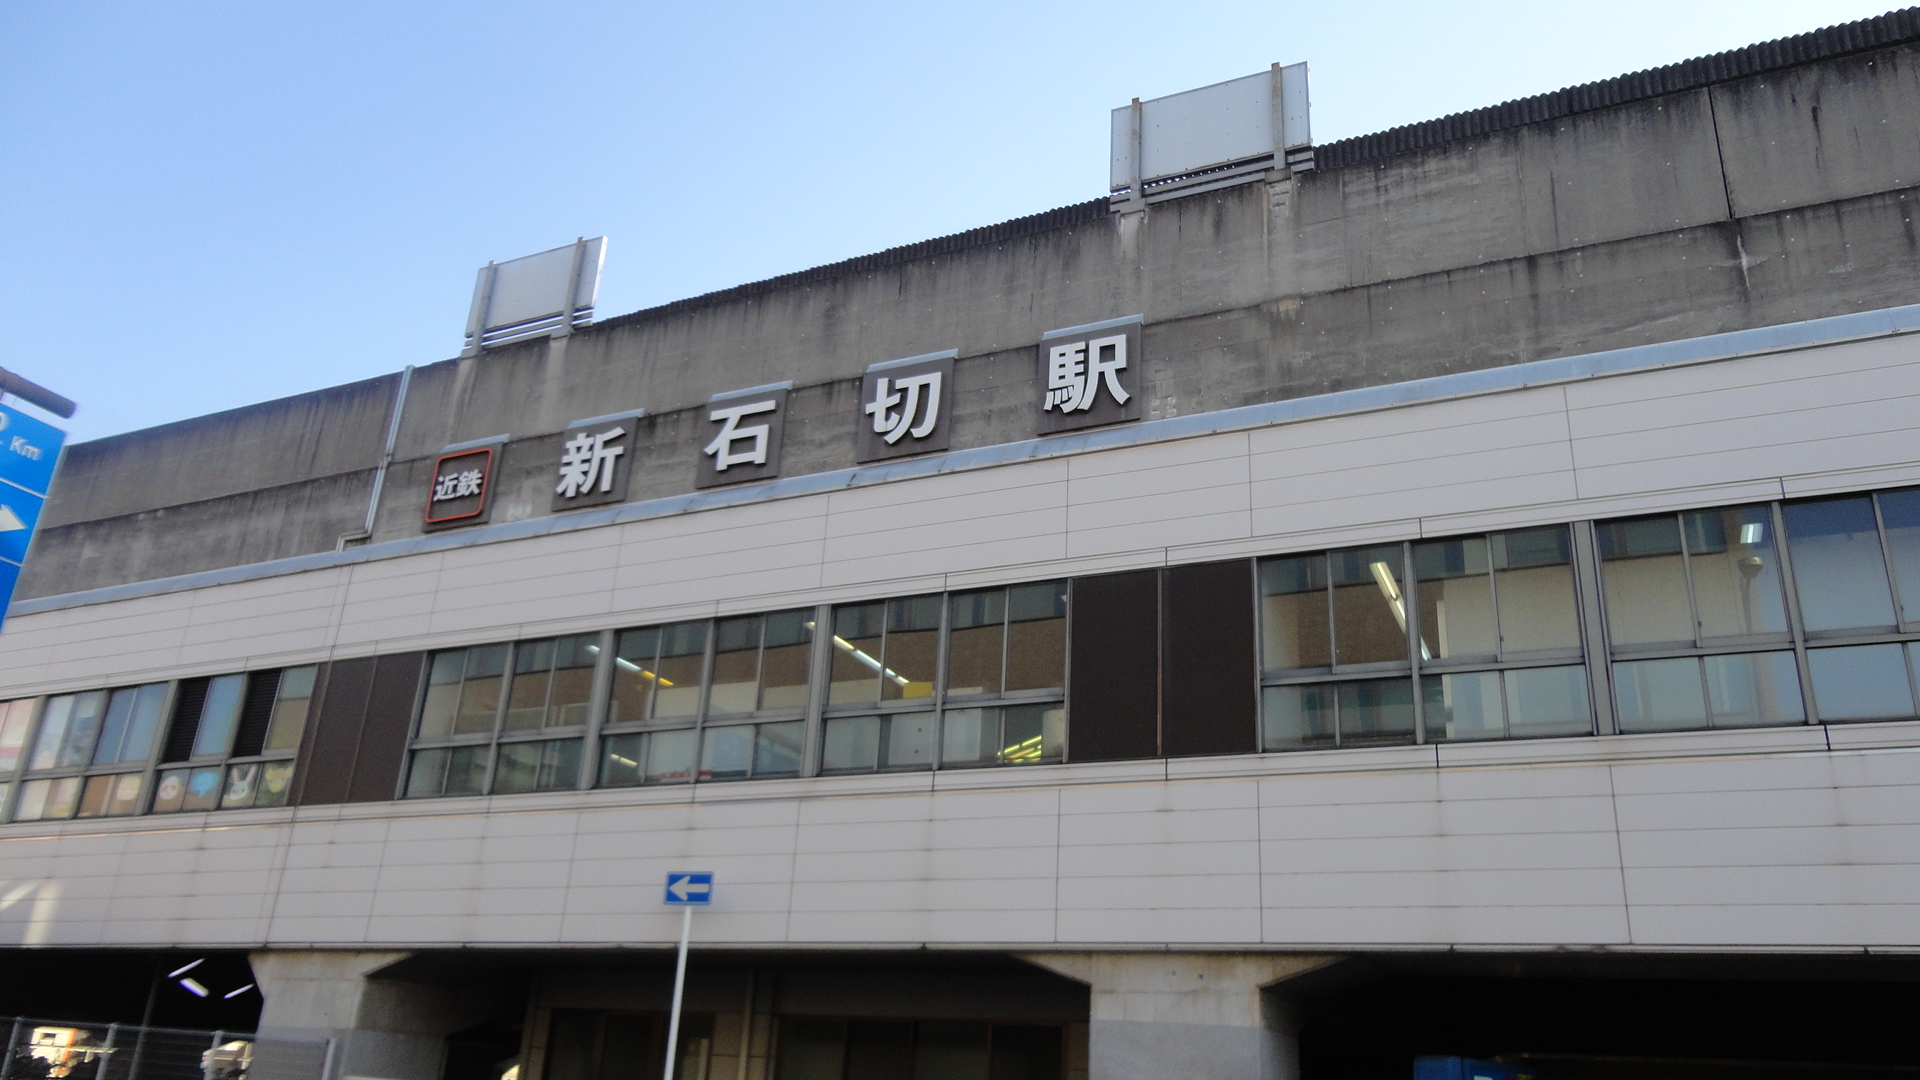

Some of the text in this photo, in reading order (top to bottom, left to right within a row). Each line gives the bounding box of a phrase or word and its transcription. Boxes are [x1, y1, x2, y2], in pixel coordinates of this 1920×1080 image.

[9, 435, 43, 461] Km
[433, 334, 1131, 502] 近鉄 新石切駅
